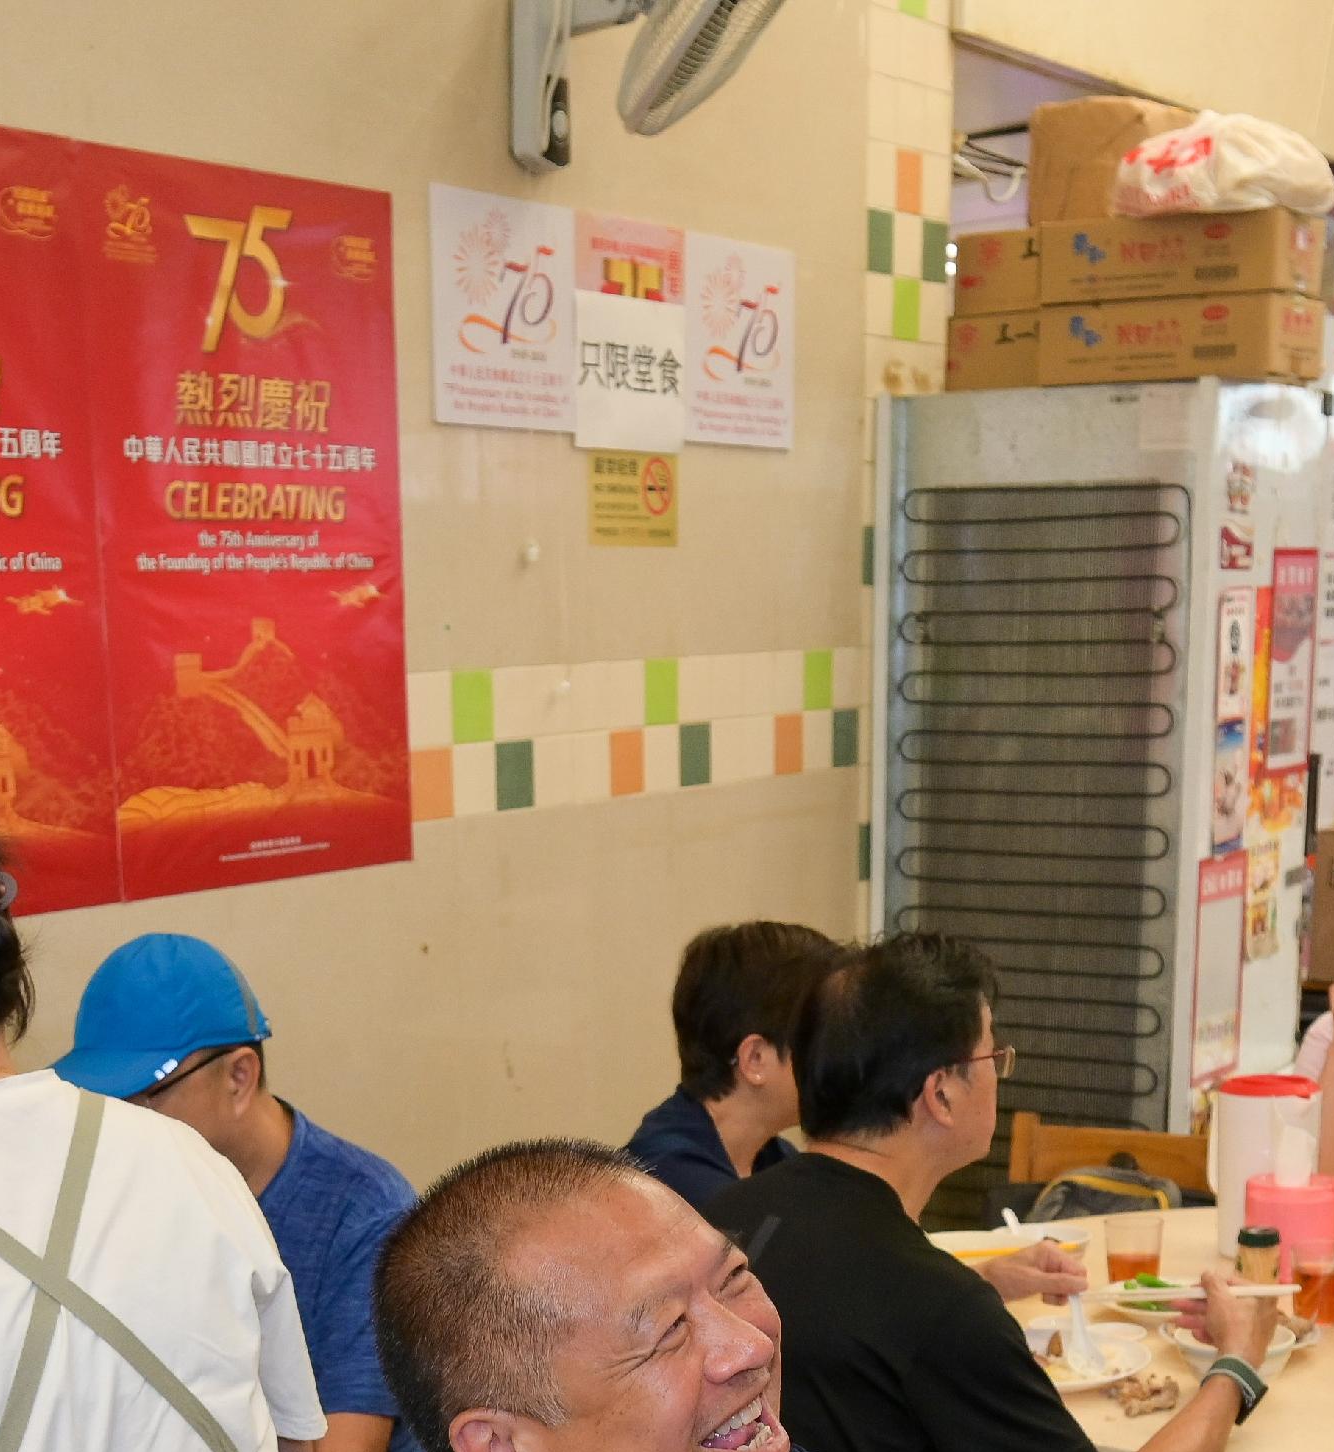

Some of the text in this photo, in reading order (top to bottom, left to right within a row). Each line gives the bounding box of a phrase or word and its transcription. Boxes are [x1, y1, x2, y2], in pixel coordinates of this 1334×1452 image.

[182, 204, 292, 353] 75
[577, 340, 683, 396] 只限堂食
[174, 371, 332, 433] 熱烈慶祝
[123, 434, 377, 473] 中華人民共和國成立七十五周年
[164, 479, 346, 522] CELEBRATING
[197, 530, 320, 551] the 75th Anniversary of
[10, 552, 25, 572] of
[27, 552, 62, 571] China
[136, 552, 375, 575] the Founding of the People's Republic of China
